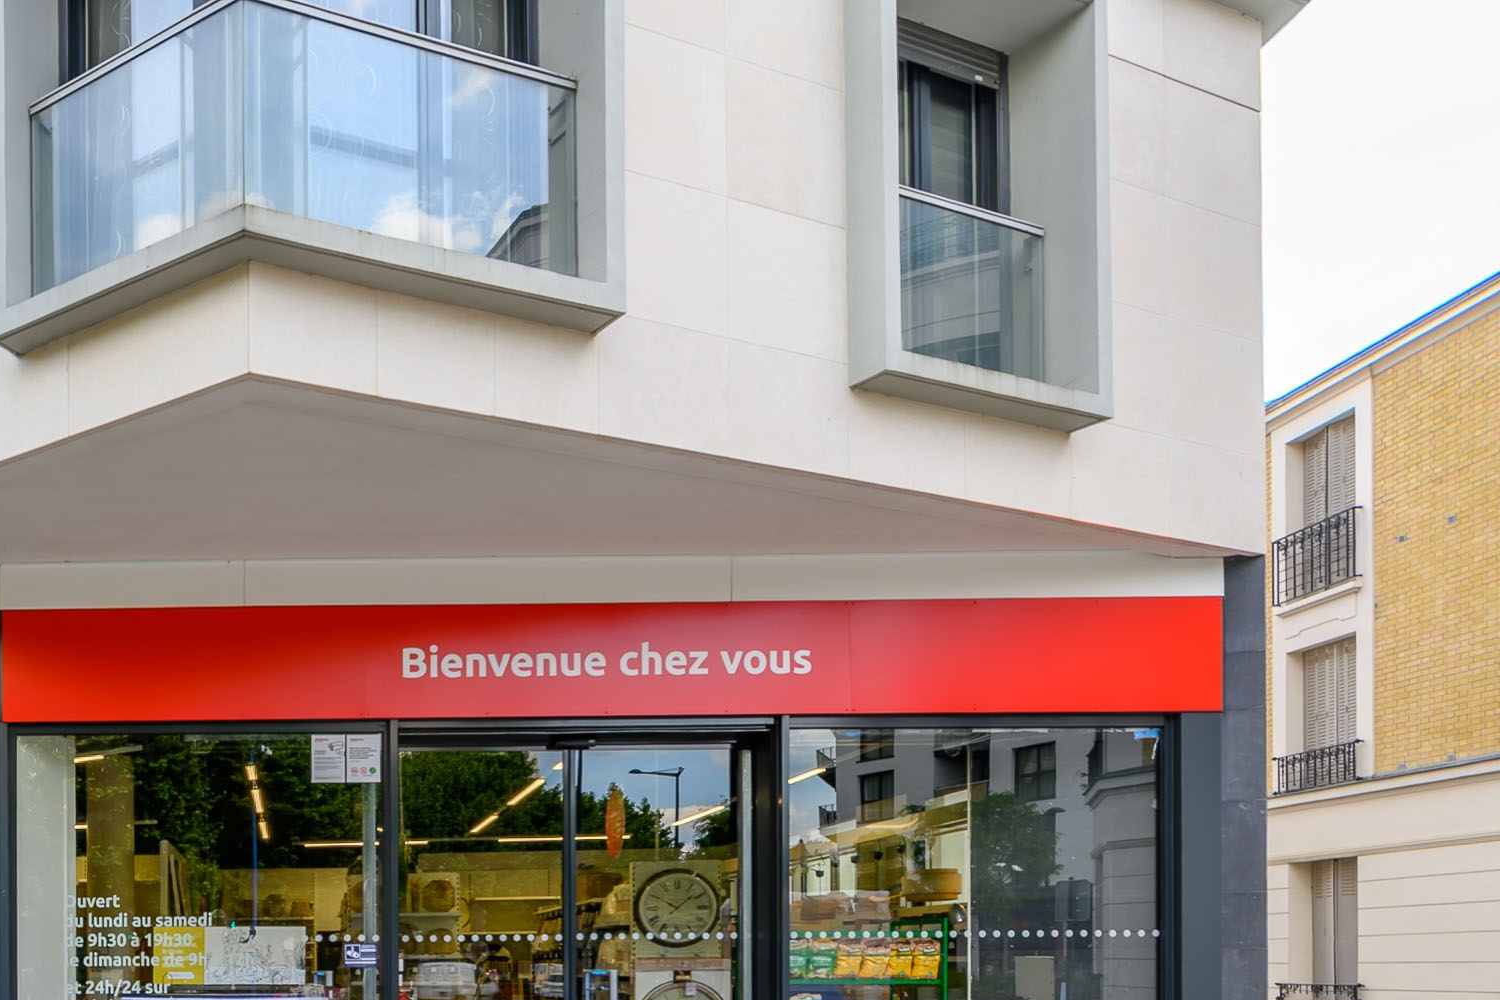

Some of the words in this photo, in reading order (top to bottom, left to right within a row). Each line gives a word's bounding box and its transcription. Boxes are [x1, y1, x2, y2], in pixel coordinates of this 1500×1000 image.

[402, 644, 607, 679] Bienvenue
[619, 641, 709, 676] chez
[720, 648, 812, 676] vous
[65, 894, 121, 909] Ouvert
[88, 912, 128, 928] lundi
[132, 915, 151, 928] au
[155, 911, 213, 927] samedi
[87, 933, 127, 948] 9h30
[130, 931, 140, 947] à
[144, 932, 192, 947] 19h30
[83, 952, 160, 967] dimanche
[163, 952, 185, 966] de
[85, 979, 142, 998] 24h/24
[145, 983, 171, 994] sur
